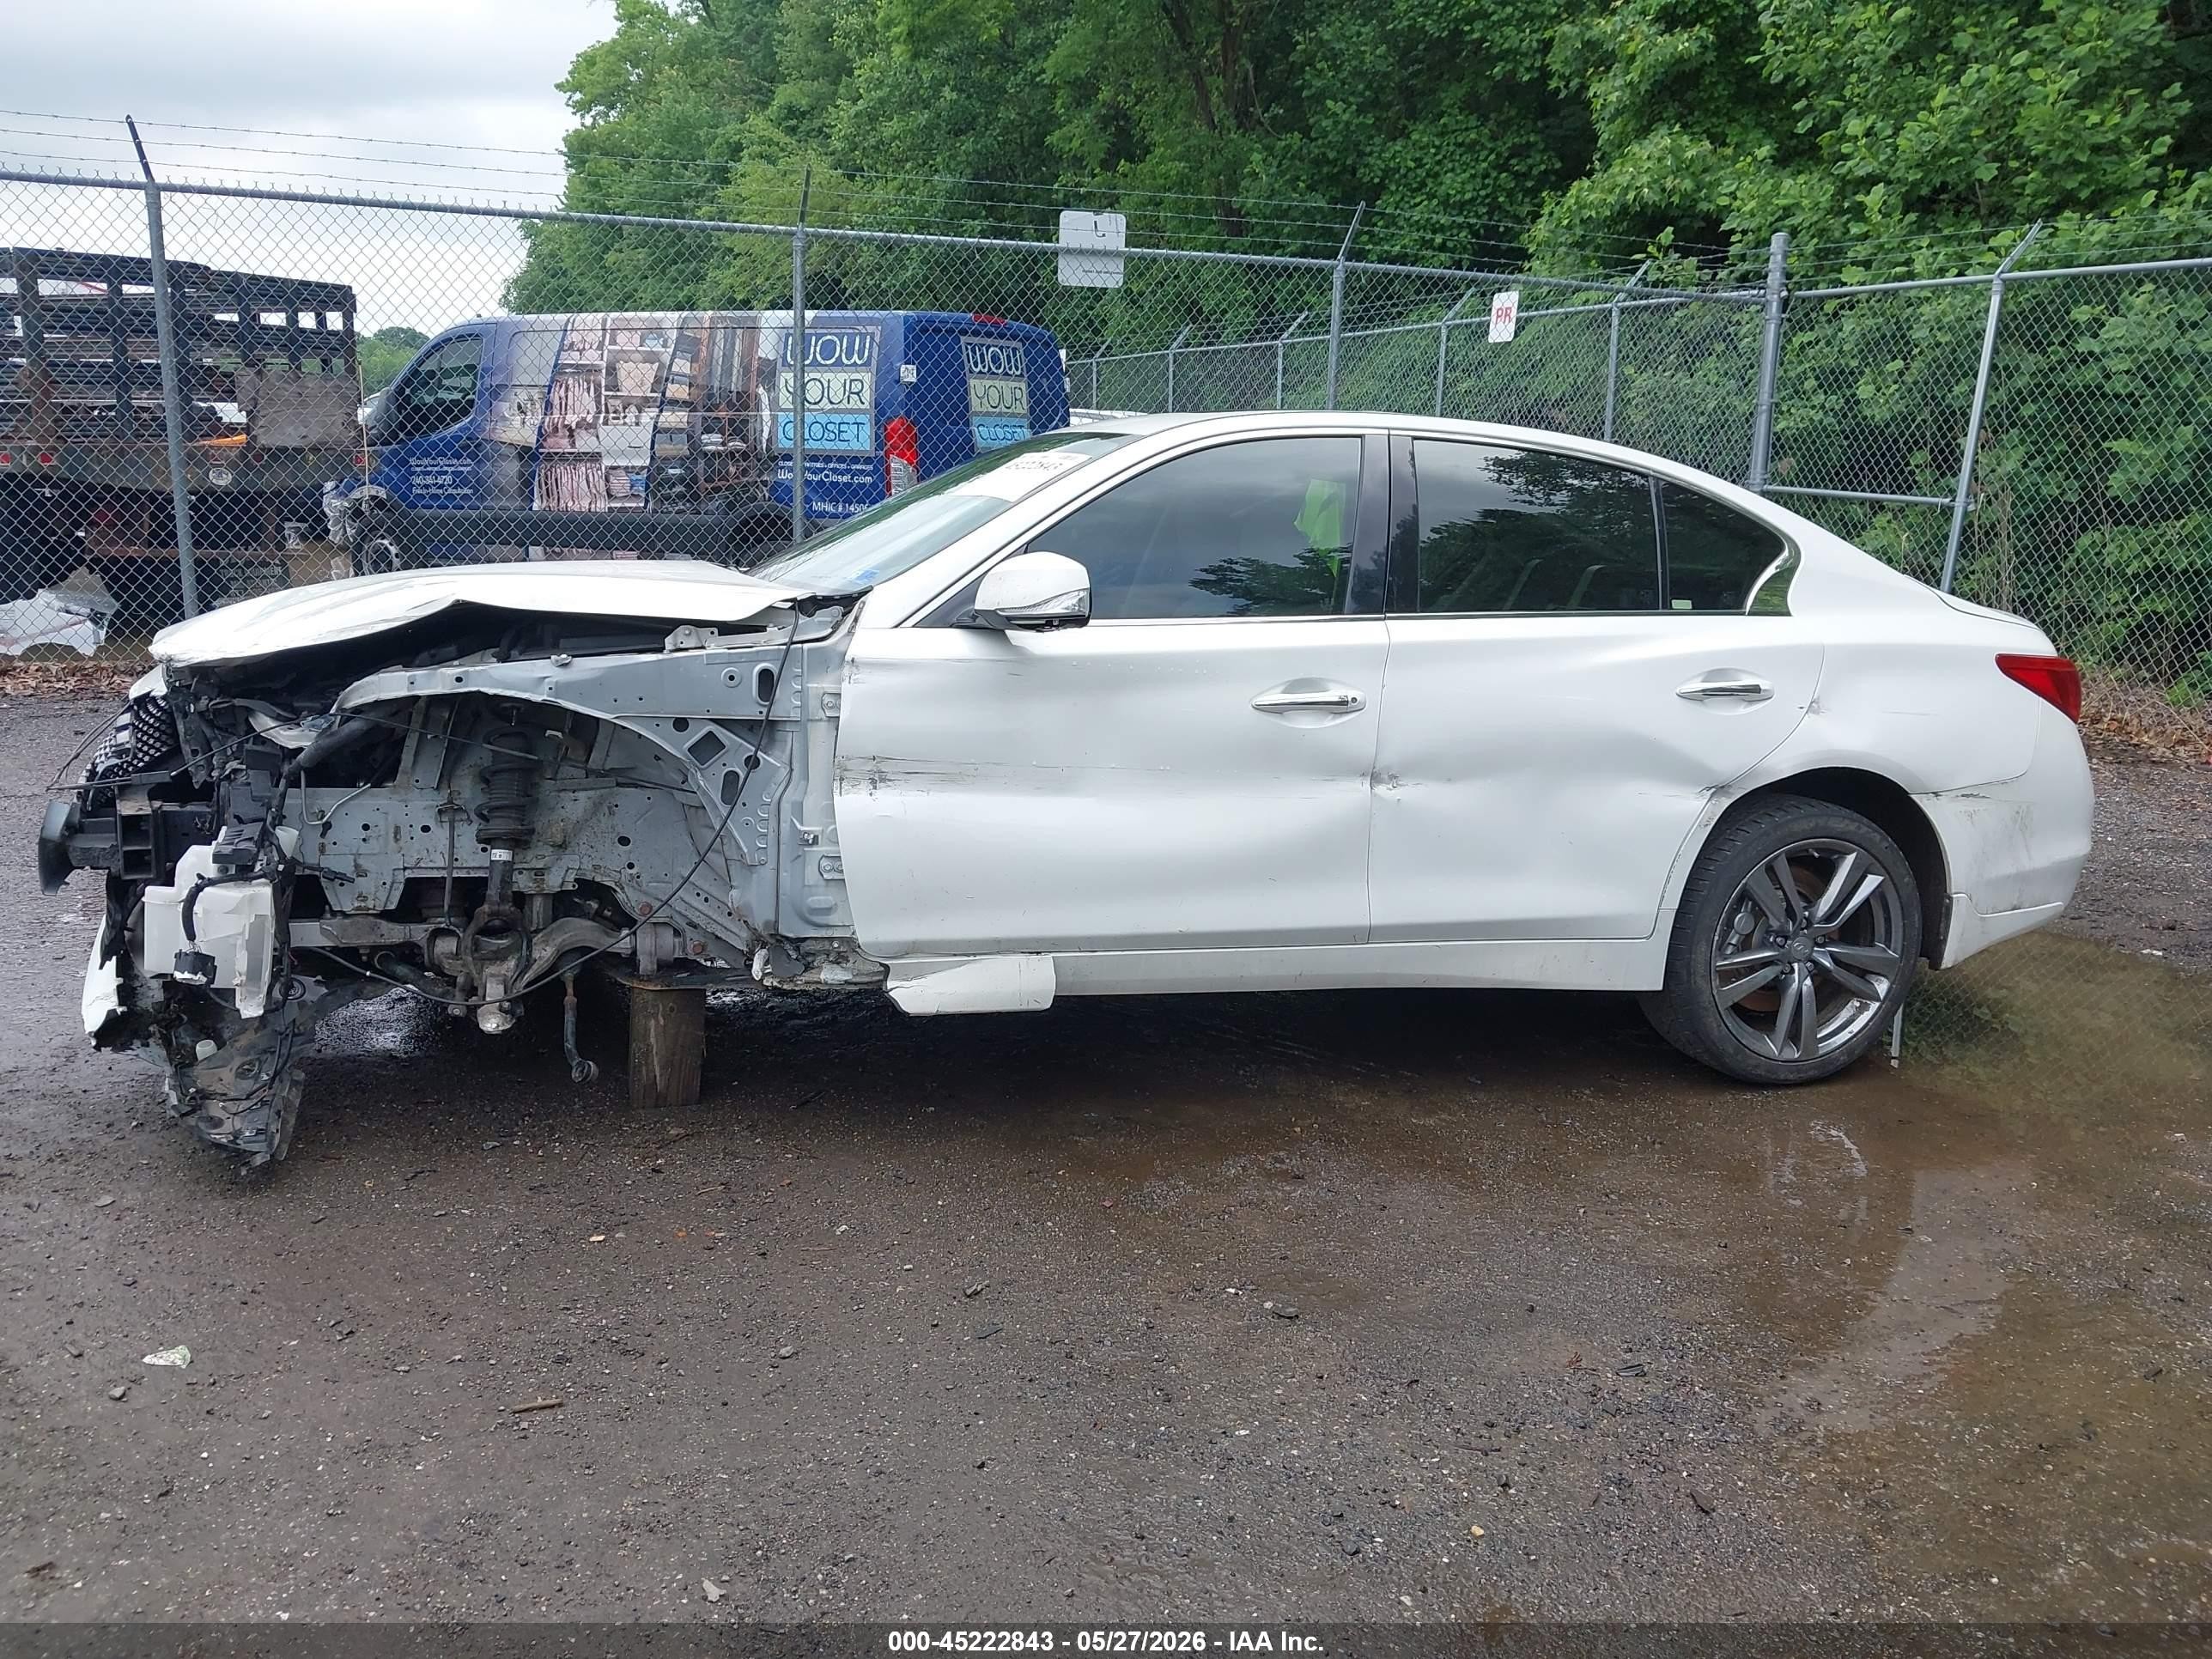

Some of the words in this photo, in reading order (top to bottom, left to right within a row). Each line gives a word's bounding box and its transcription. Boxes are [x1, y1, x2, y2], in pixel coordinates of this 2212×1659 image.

[1495, 307, 1512, 325] PR
[787, 334, 871, 365] WOW
[968, 345, 1021, 375] WOW
[973, 384, 1024, 410] YOUR
[976, 423, 1026, 441] CLOSET
[777, 468, 872, 483] WoourCloset.com
